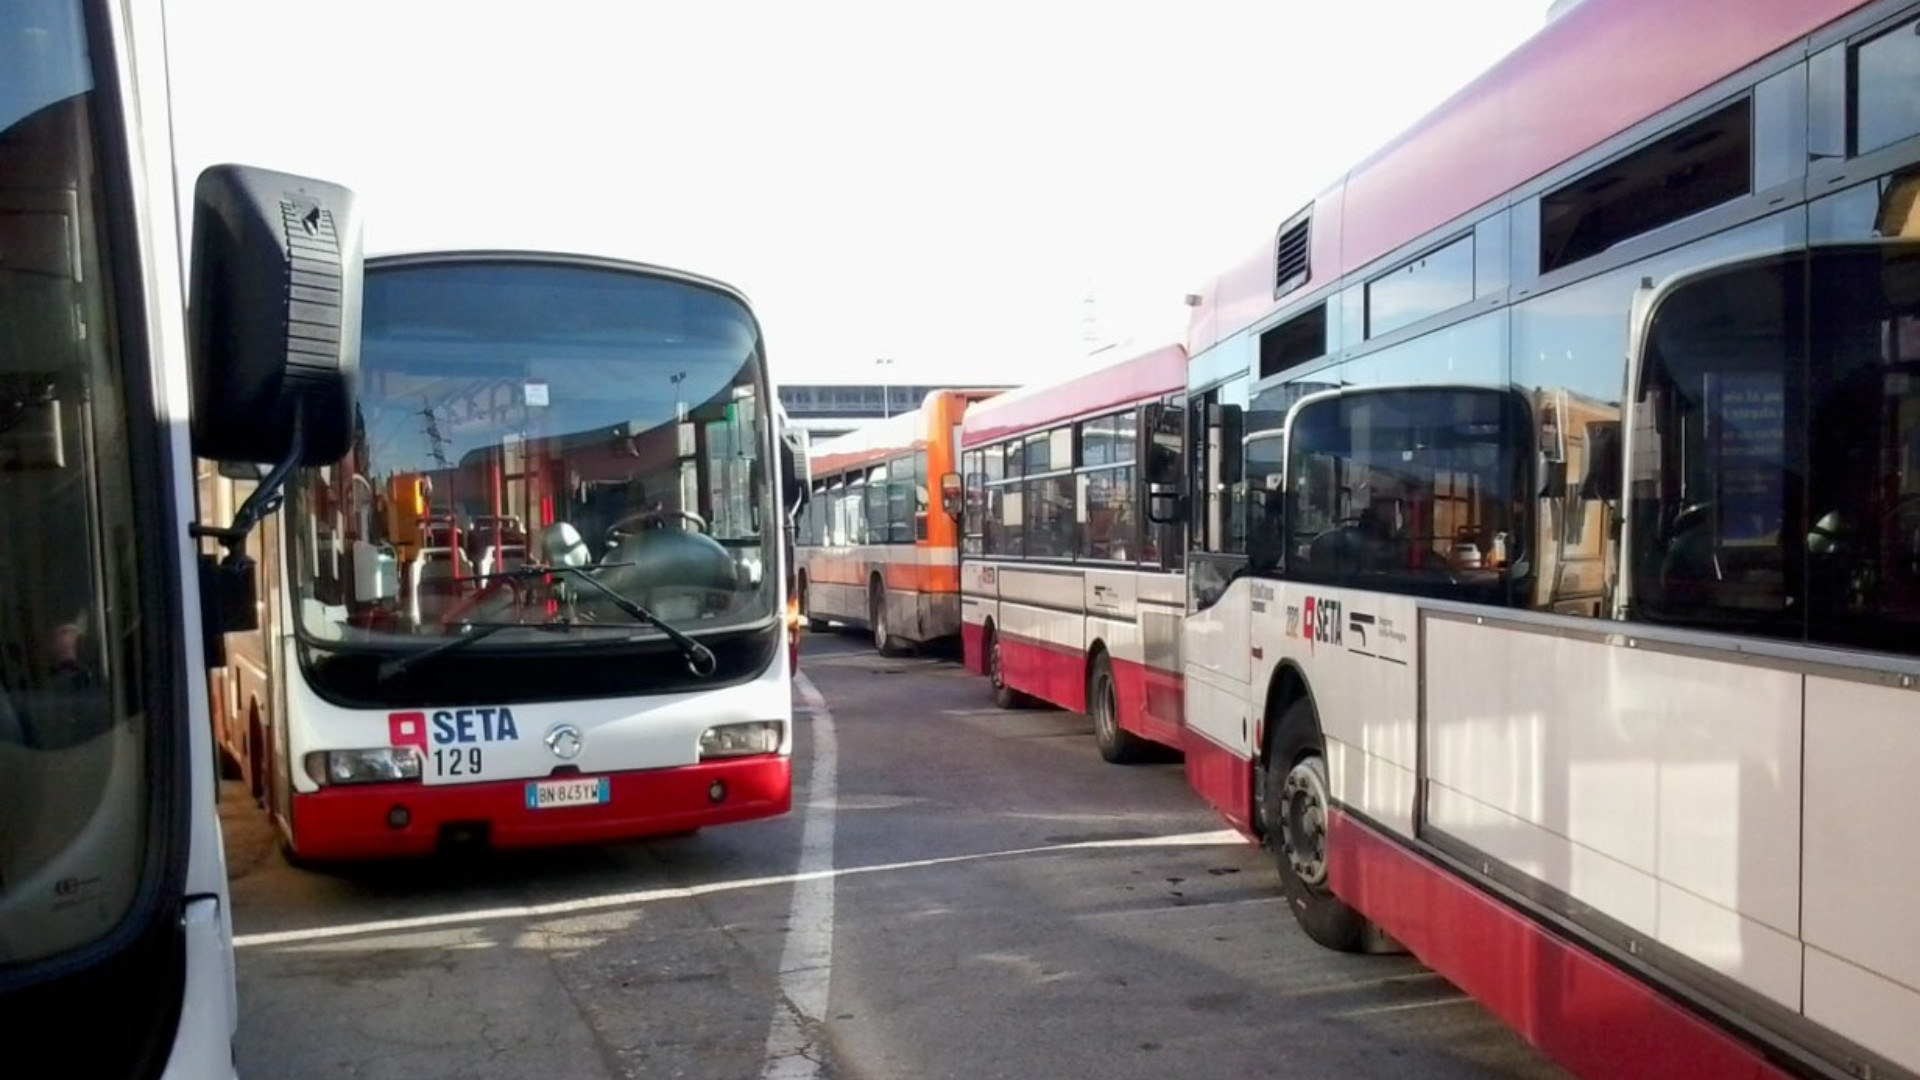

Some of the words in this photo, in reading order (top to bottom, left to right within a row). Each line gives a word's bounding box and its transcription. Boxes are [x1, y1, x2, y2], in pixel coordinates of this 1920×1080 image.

[1315, 598, 1342, 646] SETA
[432, 707, 519, 745] SETA
[434, 747, 482, 776] 129
[539, 786, 556, 803] BN
